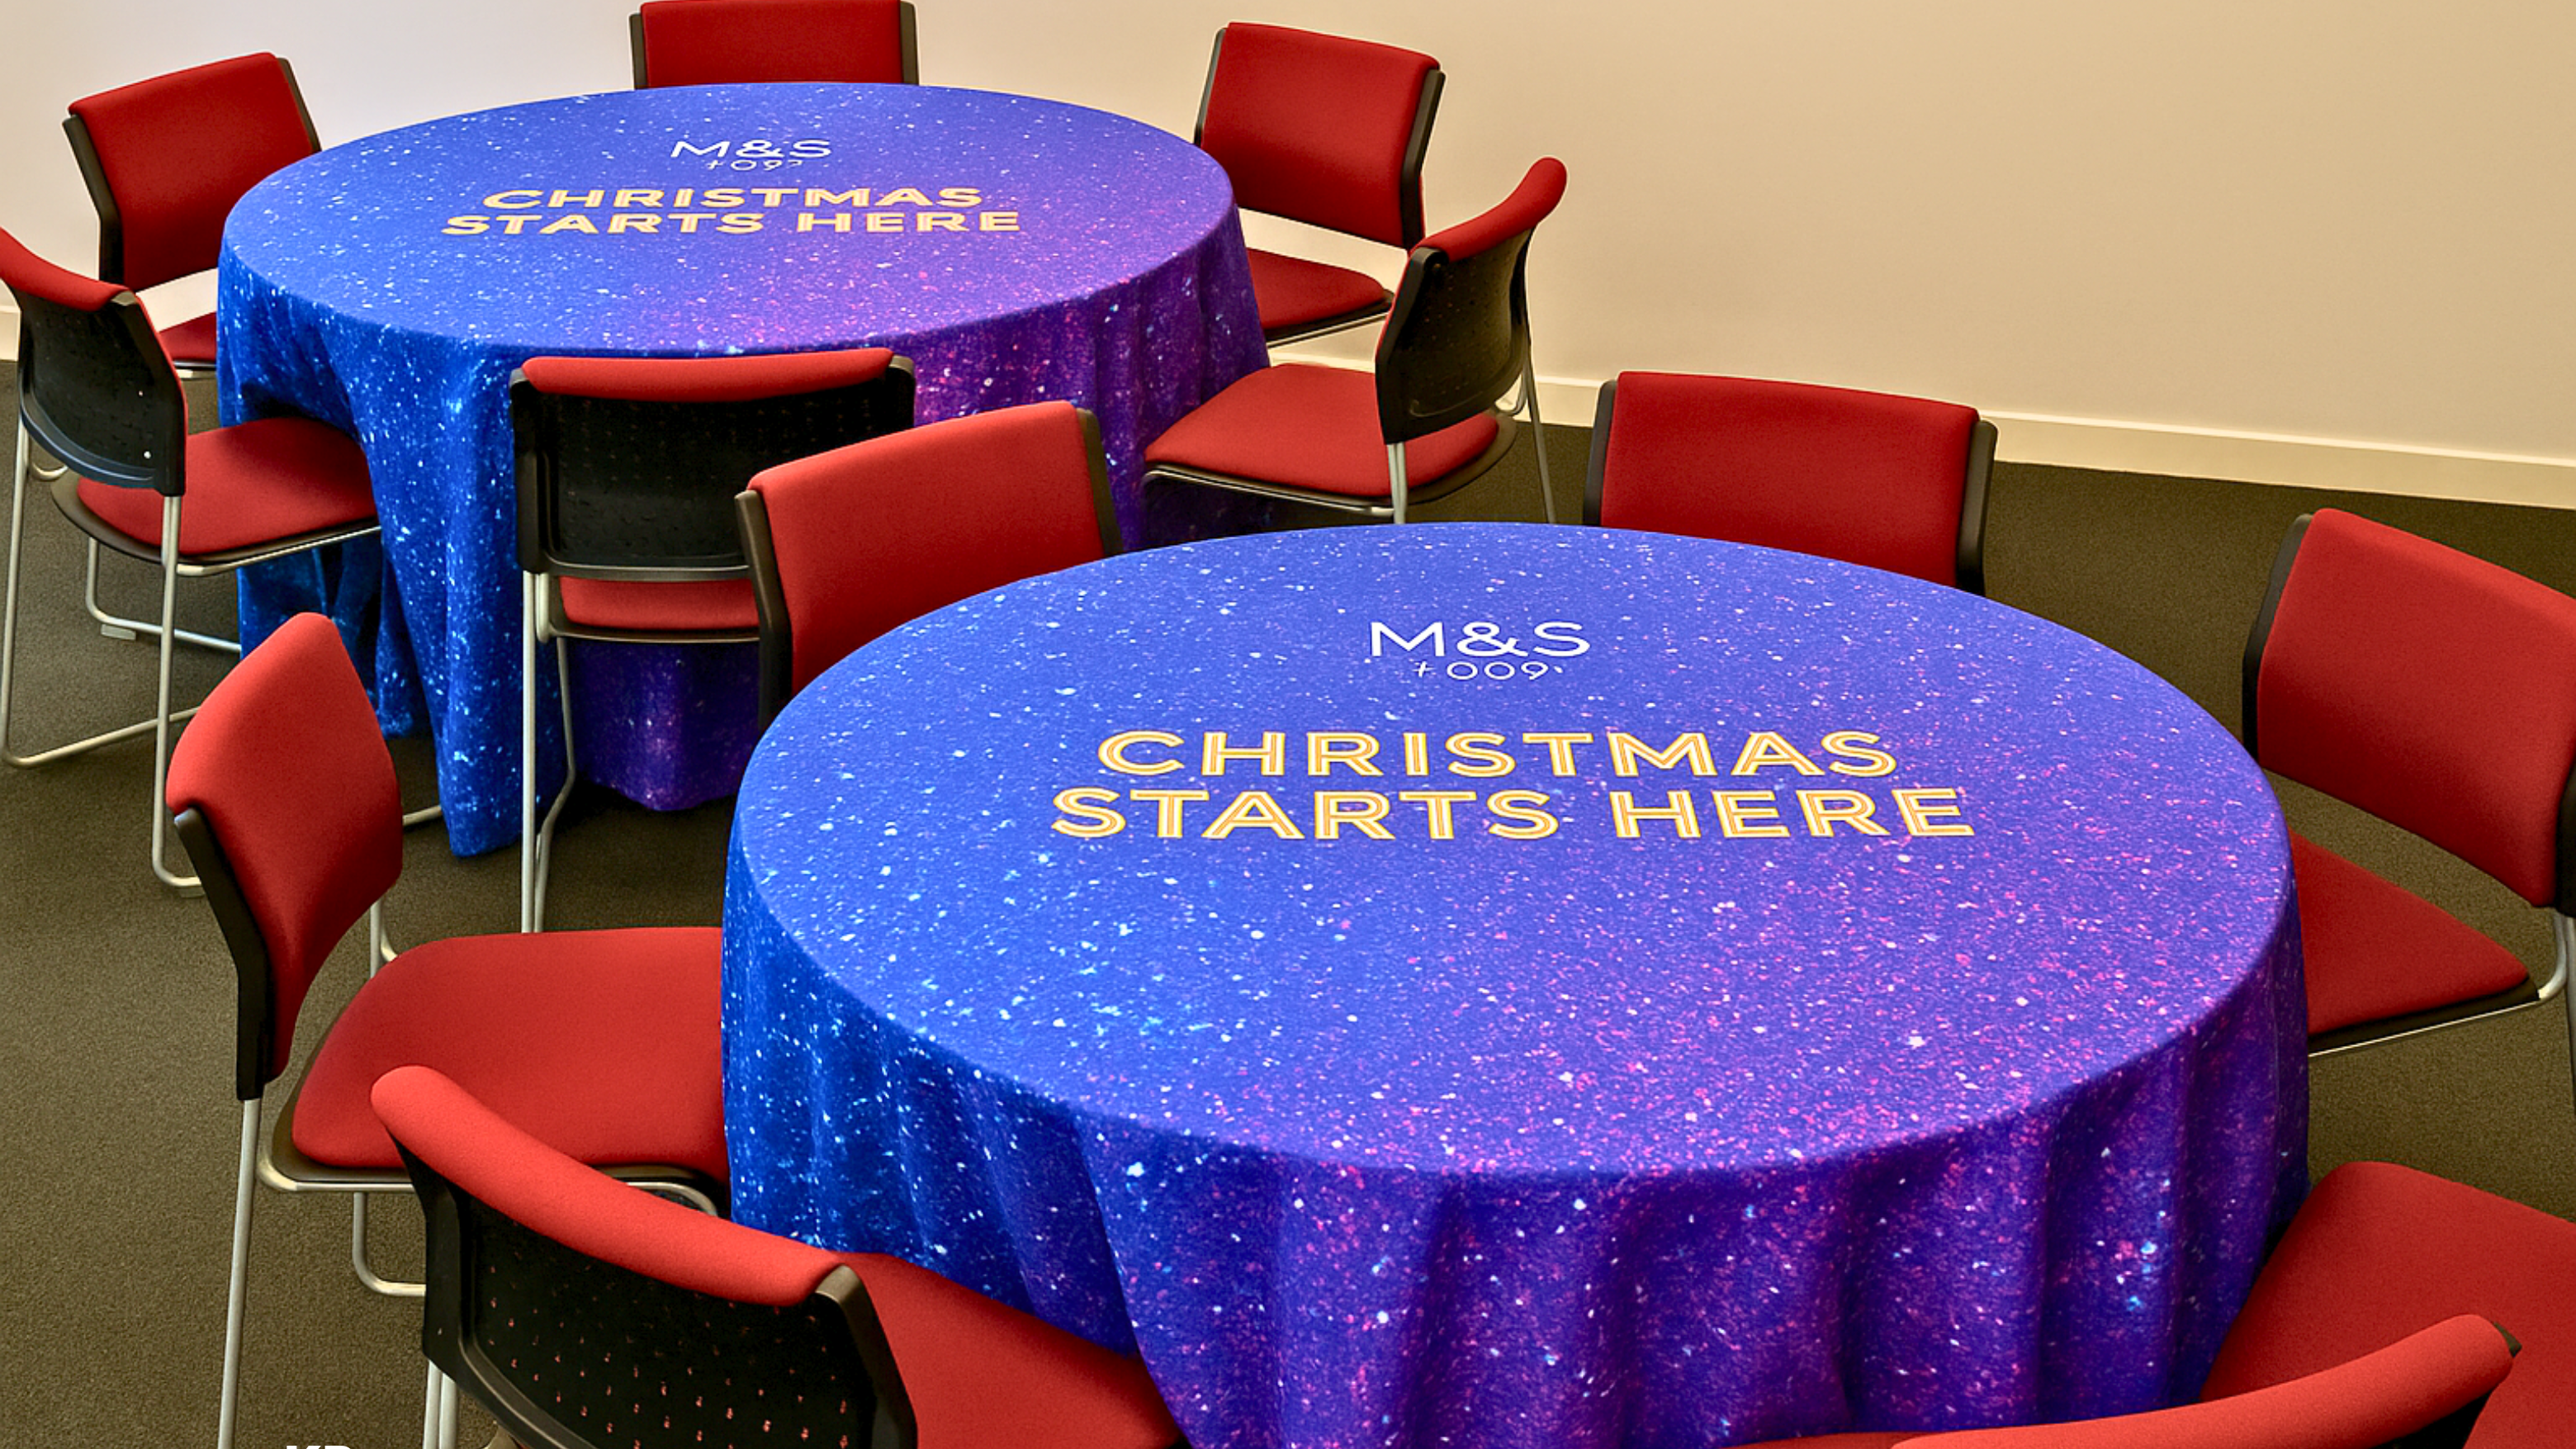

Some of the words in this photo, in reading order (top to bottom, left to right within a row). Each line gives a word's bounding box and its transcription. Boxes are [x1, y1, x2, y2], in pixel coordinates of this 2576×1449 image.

[671, 140, 831, 157] M&S
[483, 188, 983, 207] CHRISTMAS
[442, 212, 765, 234] STARTS
[797, 211, 1020, 232] HERE
[1371, 622, 1590, 656] M&S
[1098, 731, 1897, 777] CHRISTMAS
[1052, 788, 1559, 839] STARTS
[1612, 788, 1974, 837] HERE
